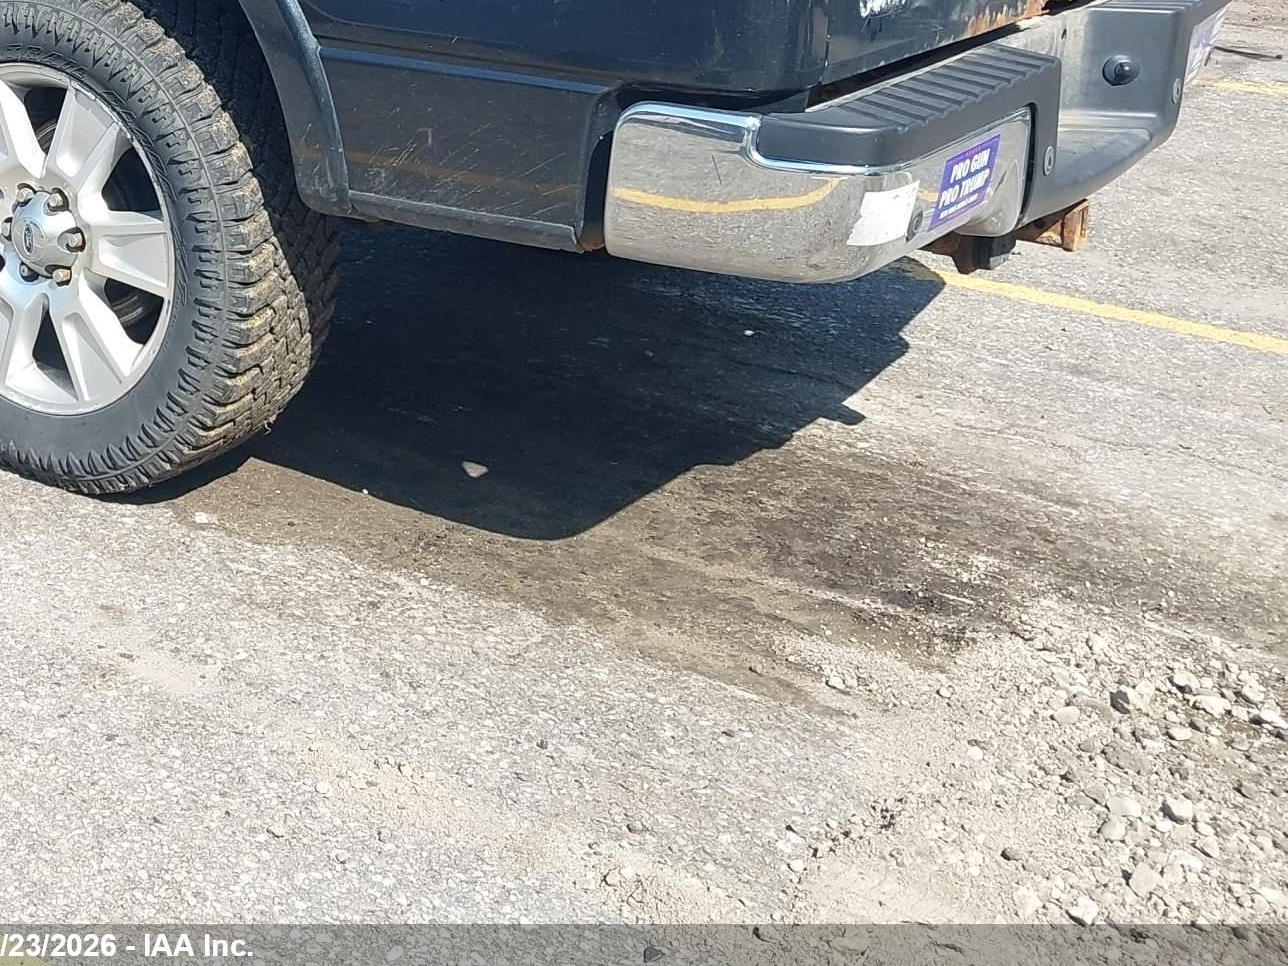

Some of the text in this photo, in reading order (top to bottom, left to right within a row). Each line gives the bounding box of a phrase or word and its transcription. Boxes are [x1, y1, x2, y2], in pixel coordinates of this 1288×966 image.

[950, 148, 991, 184] PRO GUN
[938, 185, 960, 209] PRO
[959, 168, 990, 198] TRUMP
